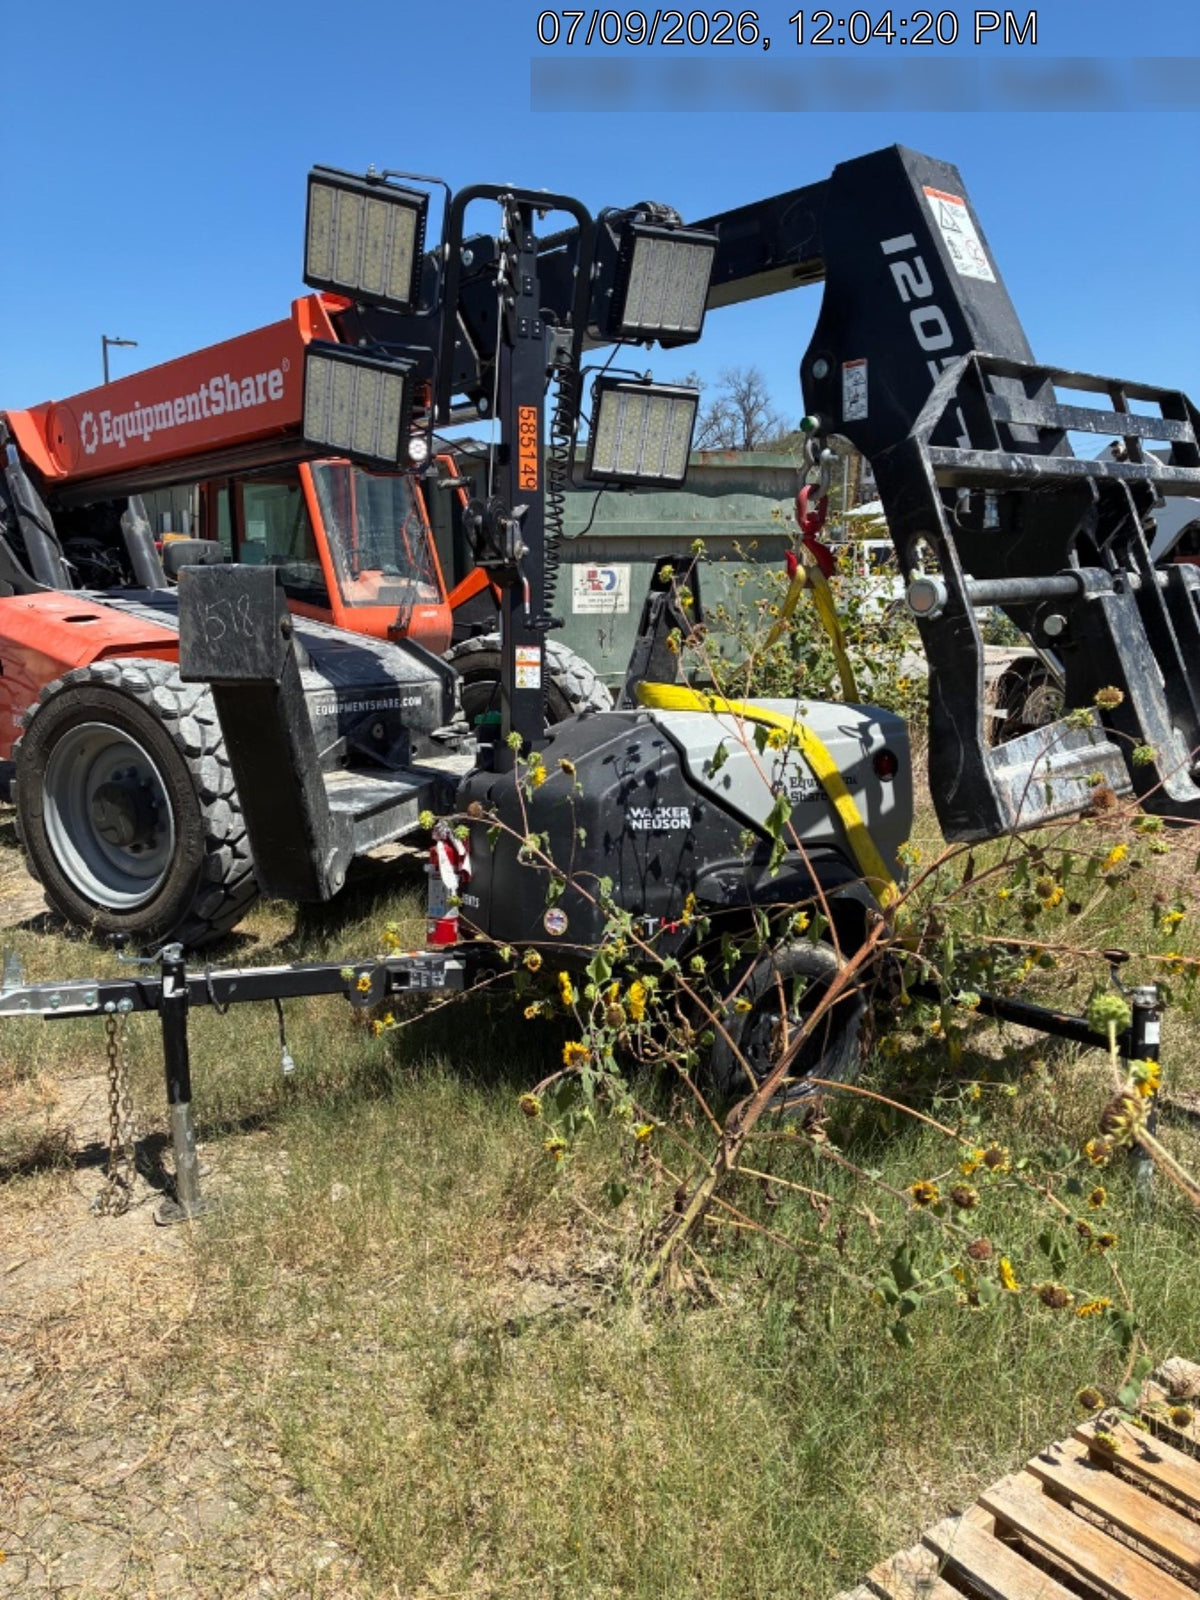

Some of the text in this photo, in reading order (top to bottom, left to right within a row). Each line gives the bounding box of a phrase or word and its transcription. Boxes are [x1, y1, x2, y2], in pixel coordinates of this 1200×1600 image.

[520, 408, 537, 489] 585149
[315, 696, 422, 715] EQUIPMENTSHARE.COM
[630, 807, 689, 818] WACKER
[632, 819, 691, 830] NEUSON
